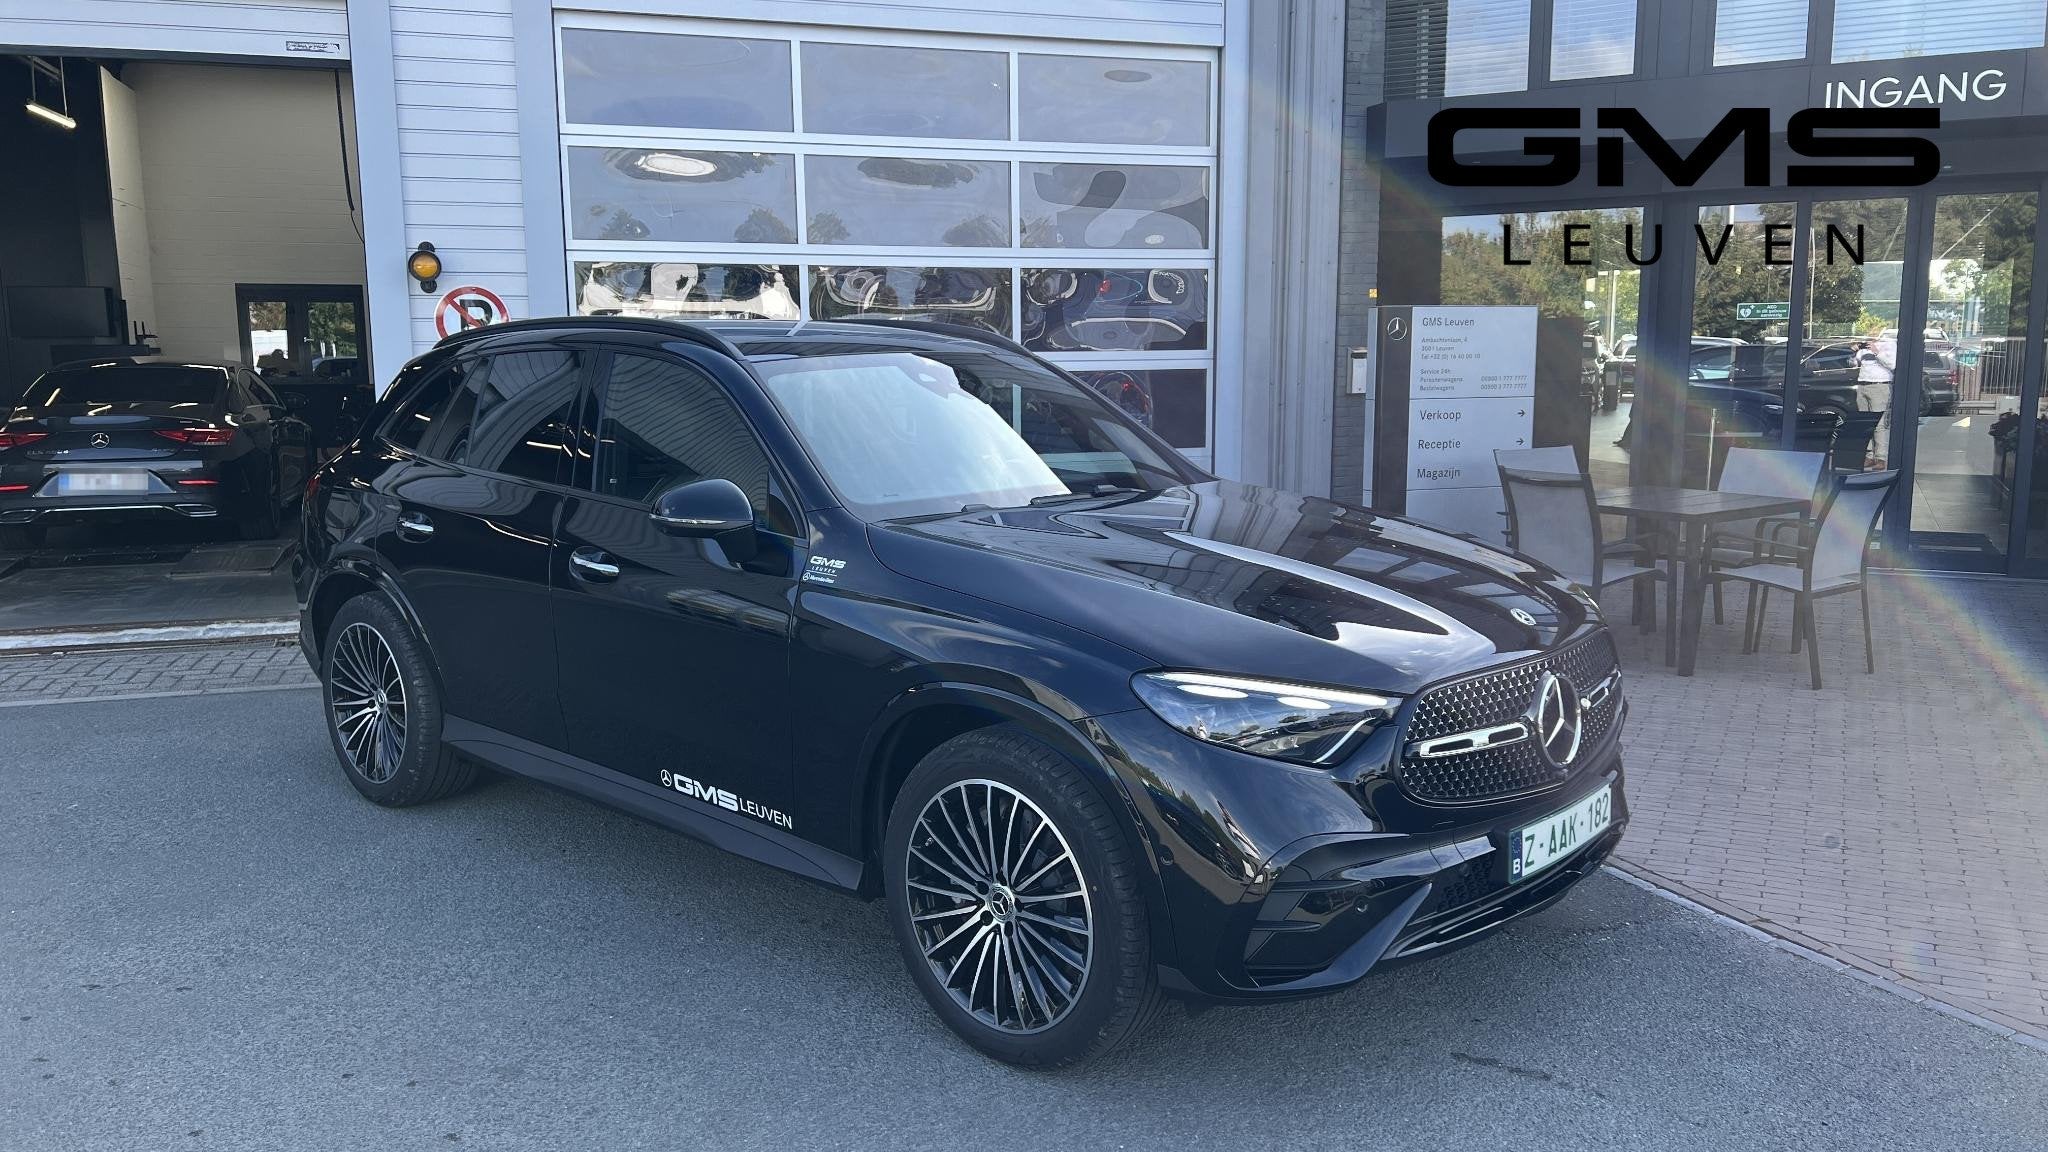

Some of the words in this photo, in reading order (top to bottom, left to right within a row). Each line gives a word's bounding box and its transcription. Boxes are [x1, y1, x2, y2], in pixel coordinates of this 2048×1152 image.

[1825, 69, 2007, 109] INGANG
[1422, 317, 1443, 327] GMS
[1444, 317, 1475, 327] Leuven
[1420, 410, 1462, 421] Verkoop
[1418, 439, 1461, 450] Receptie
[1417, 467, 1461, 481] Magazijn
[810, 555, 847, 568] GMS
[673, 773, 739, 812] GMS
[739, 797, 793, 830] LEUVEN
[1512, 858, 1521, 874] B
